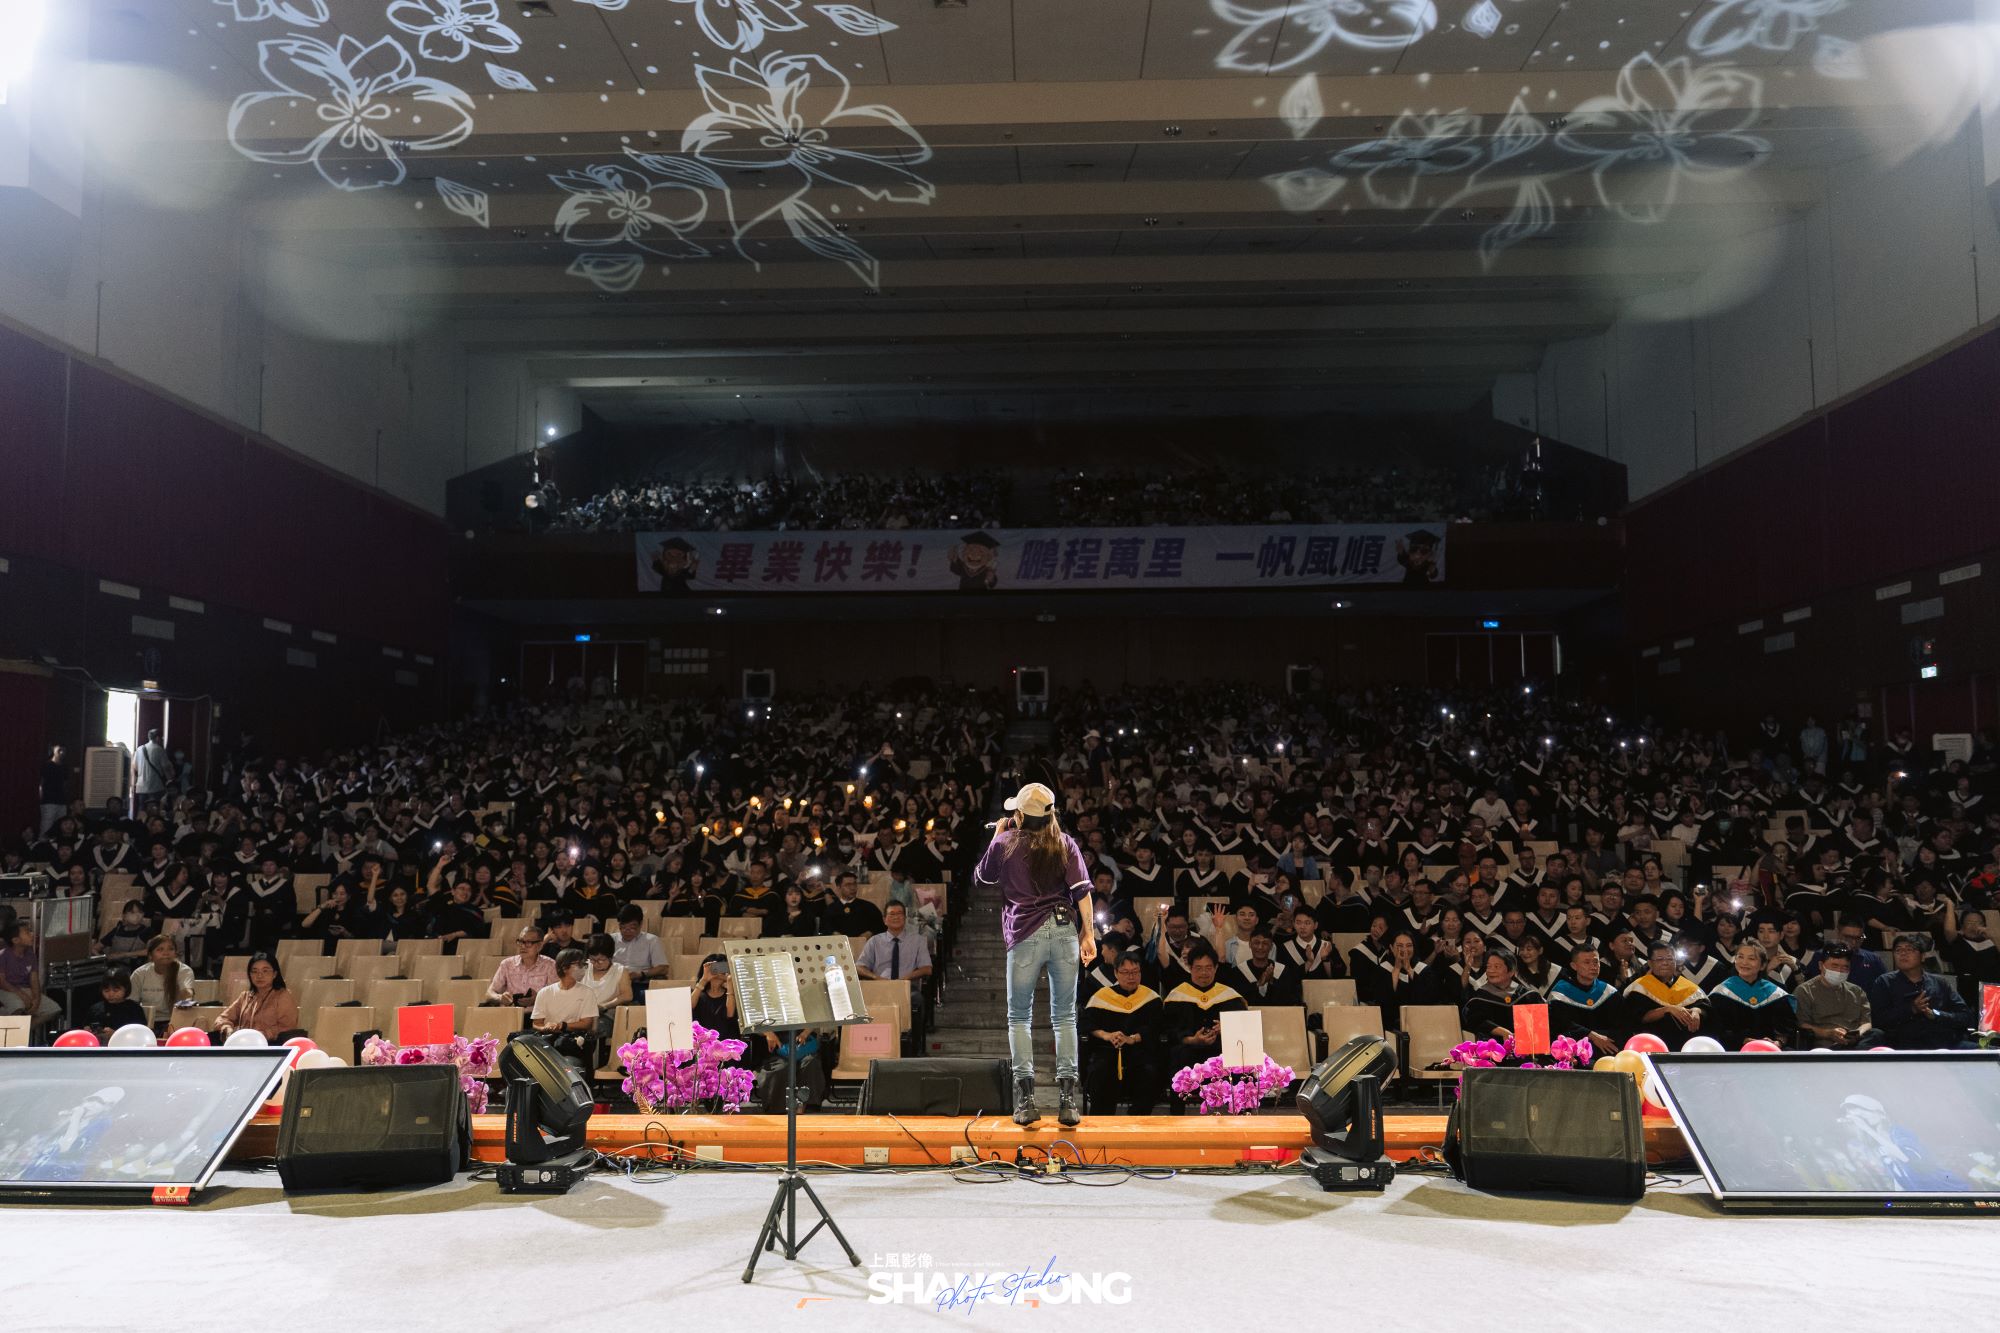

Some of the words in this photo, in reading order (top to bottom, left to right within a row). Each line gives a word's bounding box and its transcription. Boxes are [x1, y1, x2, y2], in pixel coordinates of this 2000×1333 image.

[1015, 537, 1186, 580] 鵬程萬里
[1215, 535, 1387, 578] 一帆風順
